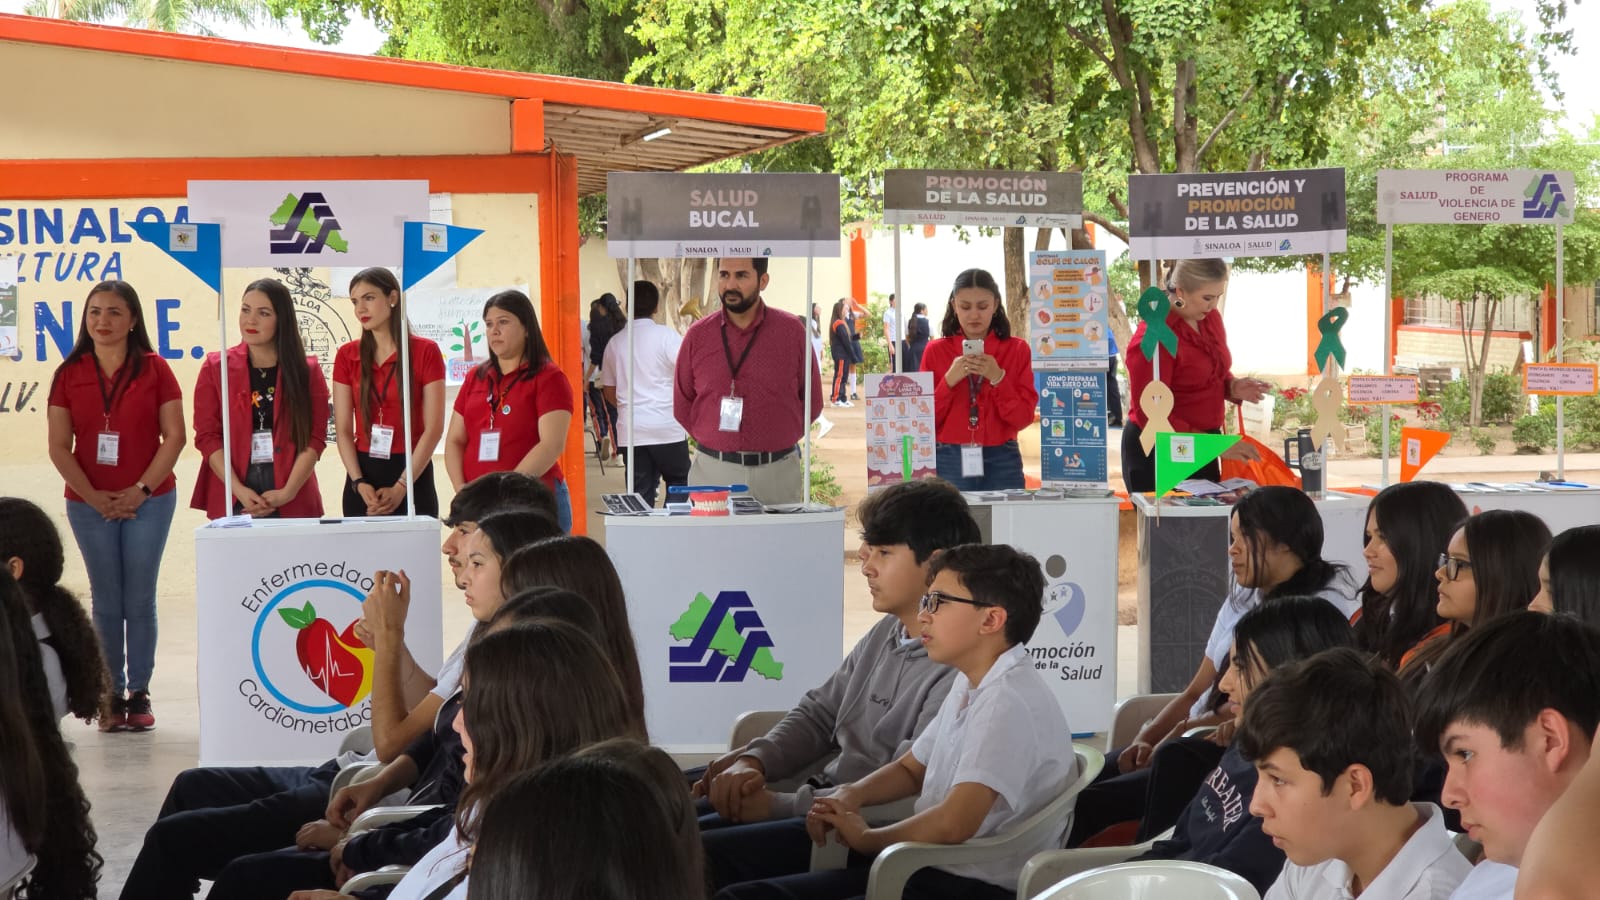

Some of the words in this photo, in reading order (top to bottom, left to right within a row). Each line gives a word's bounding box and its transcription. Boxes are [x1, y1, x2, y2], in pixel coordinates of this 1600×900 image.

[926, 175, 1047, 191] PROMOCIÓN
[1445, 172, 1509, 182] PROGRAMA
[1177, 177, 1289, 197] PREVENCIÓN
[1294, 179, 1306, 193] Y
[1470, 185, 1485, 195] DE
[690, 189, 758, 207] SALUD
[926, 190, 951, 204] DE
[956, 191, 981, 205] LA
[985, 192, 1048, 207] SALUD
[1400, 191, 1438, 200] SALUD
[1438, 199, 1498, 208] VIOLENCIA
[1501, 199, 1516, 208] DE
[1187, 195, 1296, 214] PROMOCIÓN
[689, 210, 760, 228] BUCAL
[917, 213, 946, 221] SALUD
[1185, 216, 1210, 231] DE
[1215, 215, 1237, 230] LA
[1242, 213, 1299, 230] SALUD
[1453, 211, 1500, 221] GENERO
[0, 205, 188, 245] SINALO
[1204, 242, 1241, 250] SINALOA
[1035, 661, 1047, 670] de
[1049, 661, 1059, 669] la
[1060, 664, 1103, 681] Salud
[238, 679, 372, 734] Cardiometabó
